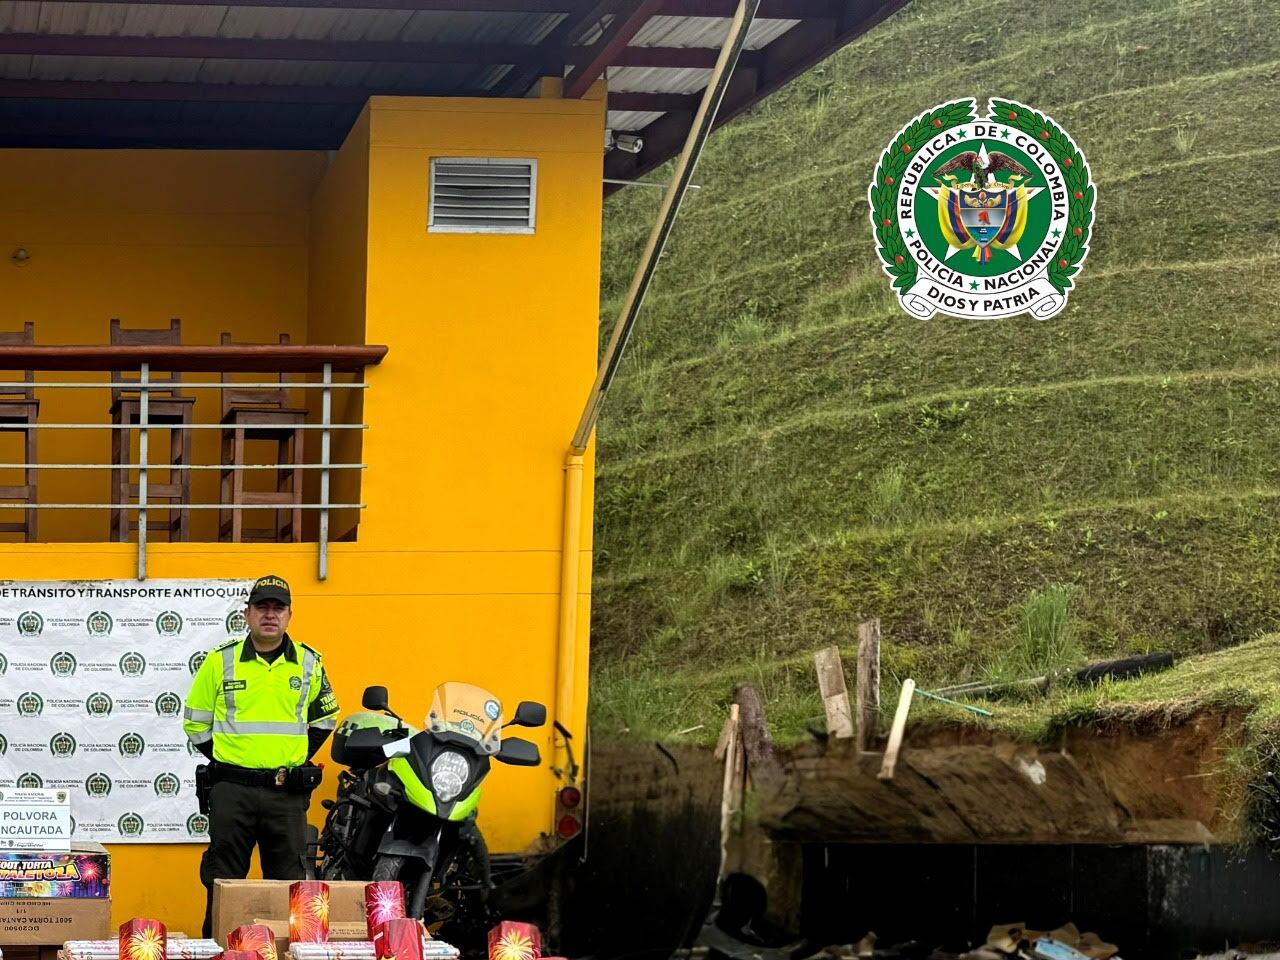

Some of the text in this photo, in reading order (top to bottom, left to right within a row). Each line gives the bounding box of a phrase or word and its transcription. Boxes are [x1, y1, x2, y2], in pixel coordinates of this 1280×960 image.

[13, 586, 75, 598] TRÁNSITO
[78, 588, 86, 598] Y
[89, 588, 170, 598] TRANSPORTE
[174, 588, 248, 598] ANTIOQUIA
[4, 812, 58, 820] POLVORA
[22, 861, 52, 870] TORTA
